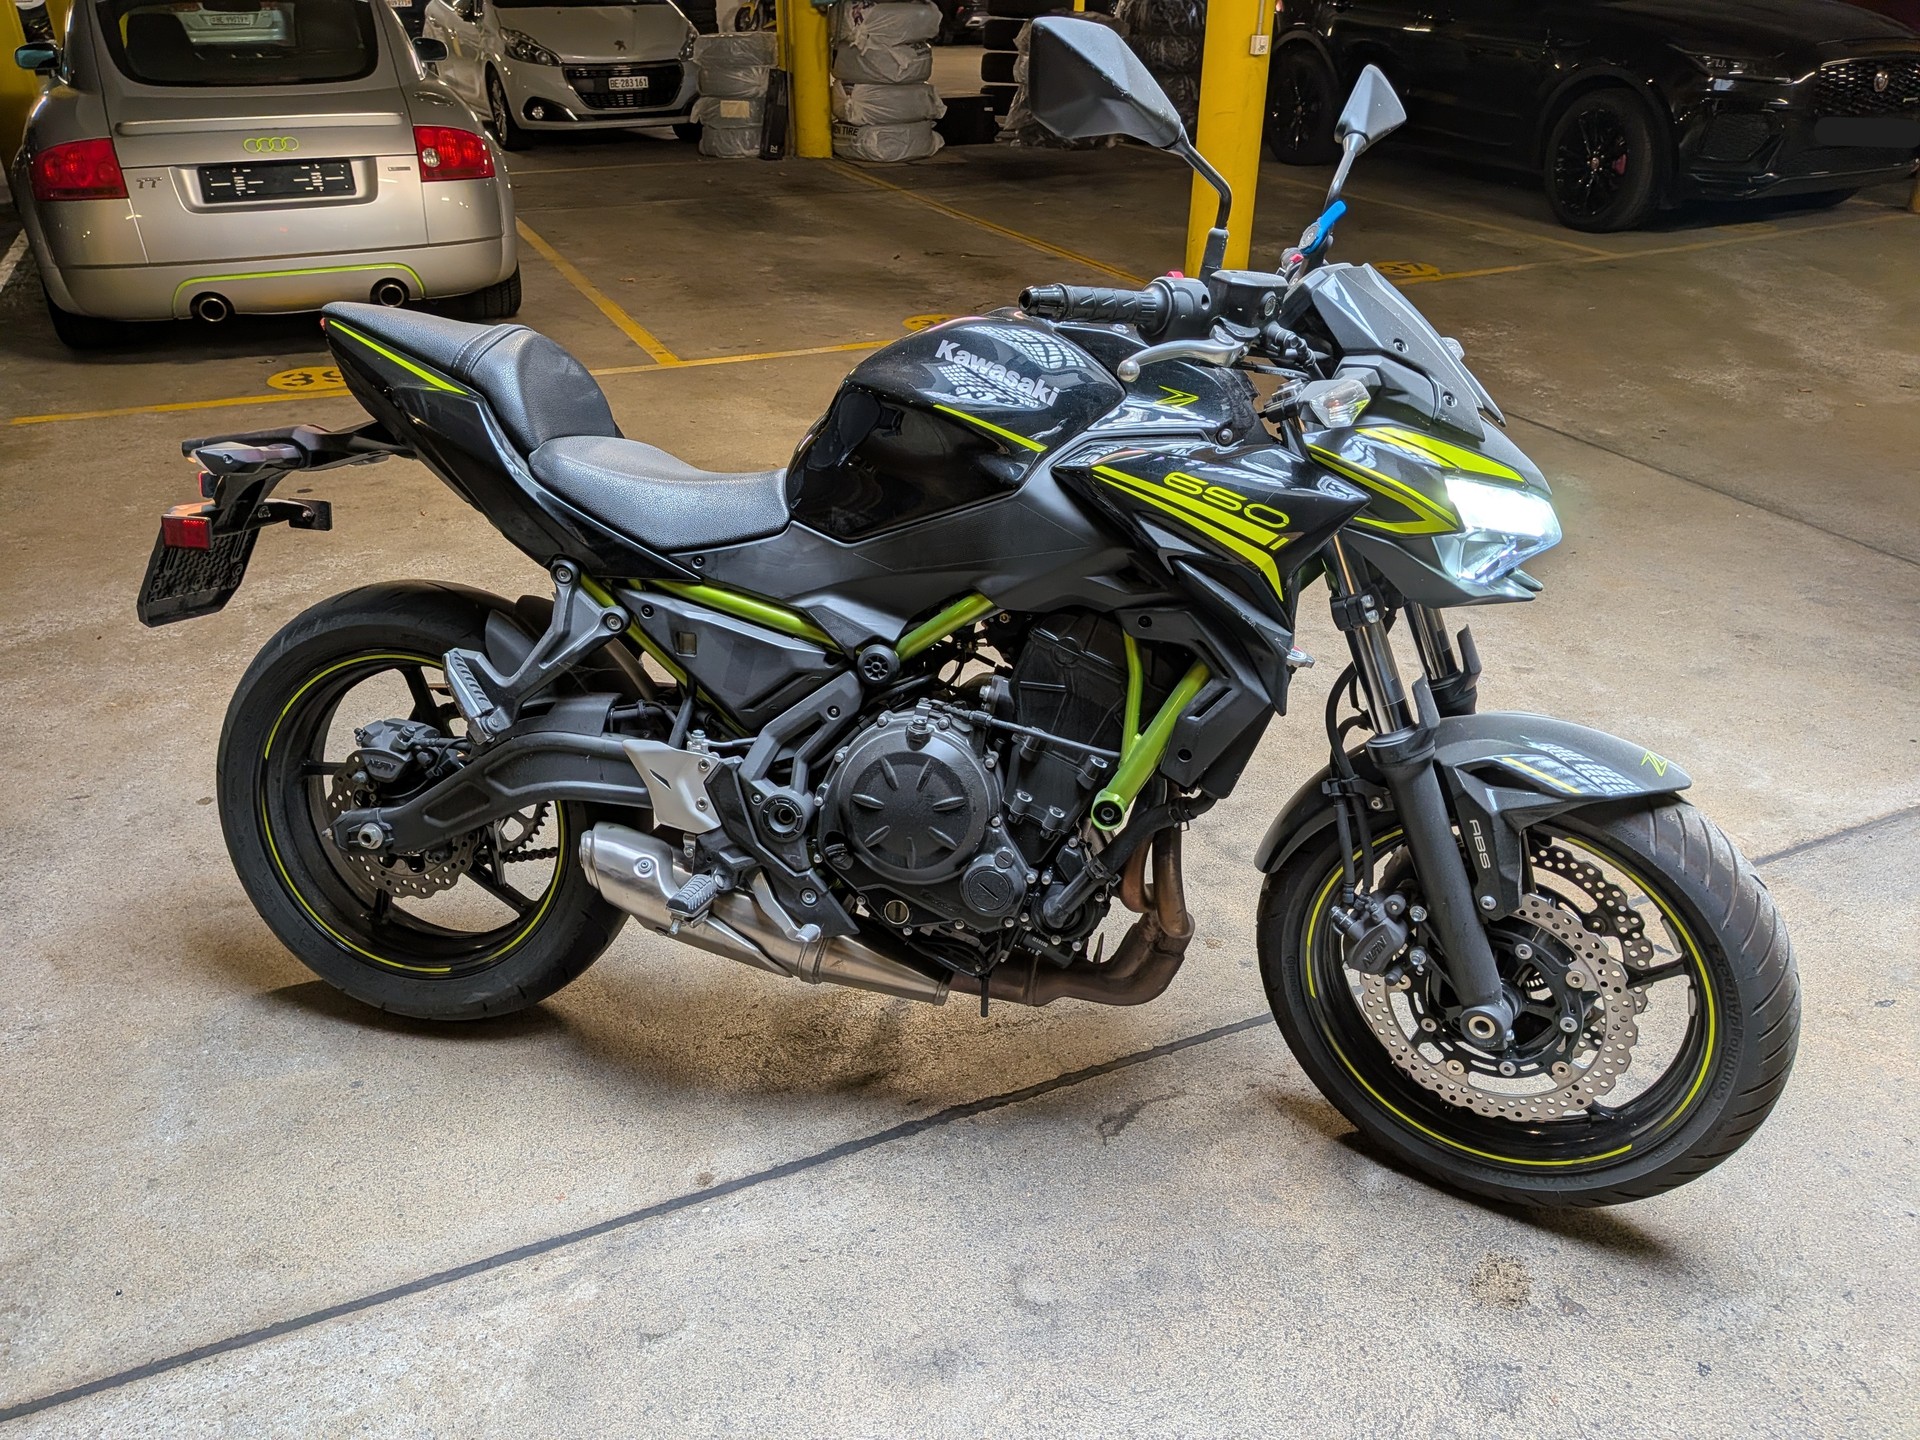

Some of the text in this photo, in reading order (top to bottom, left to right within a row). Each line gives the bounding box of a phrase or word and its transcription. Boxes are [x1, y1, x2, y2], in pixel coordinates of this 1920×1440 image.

[841, 126, 860, 137] TIRE
[935, 339, 1061, 407] Kawasaki
[1163, 471, 1290, 528] 650
[1469, 819, 1491, 869] ABS
